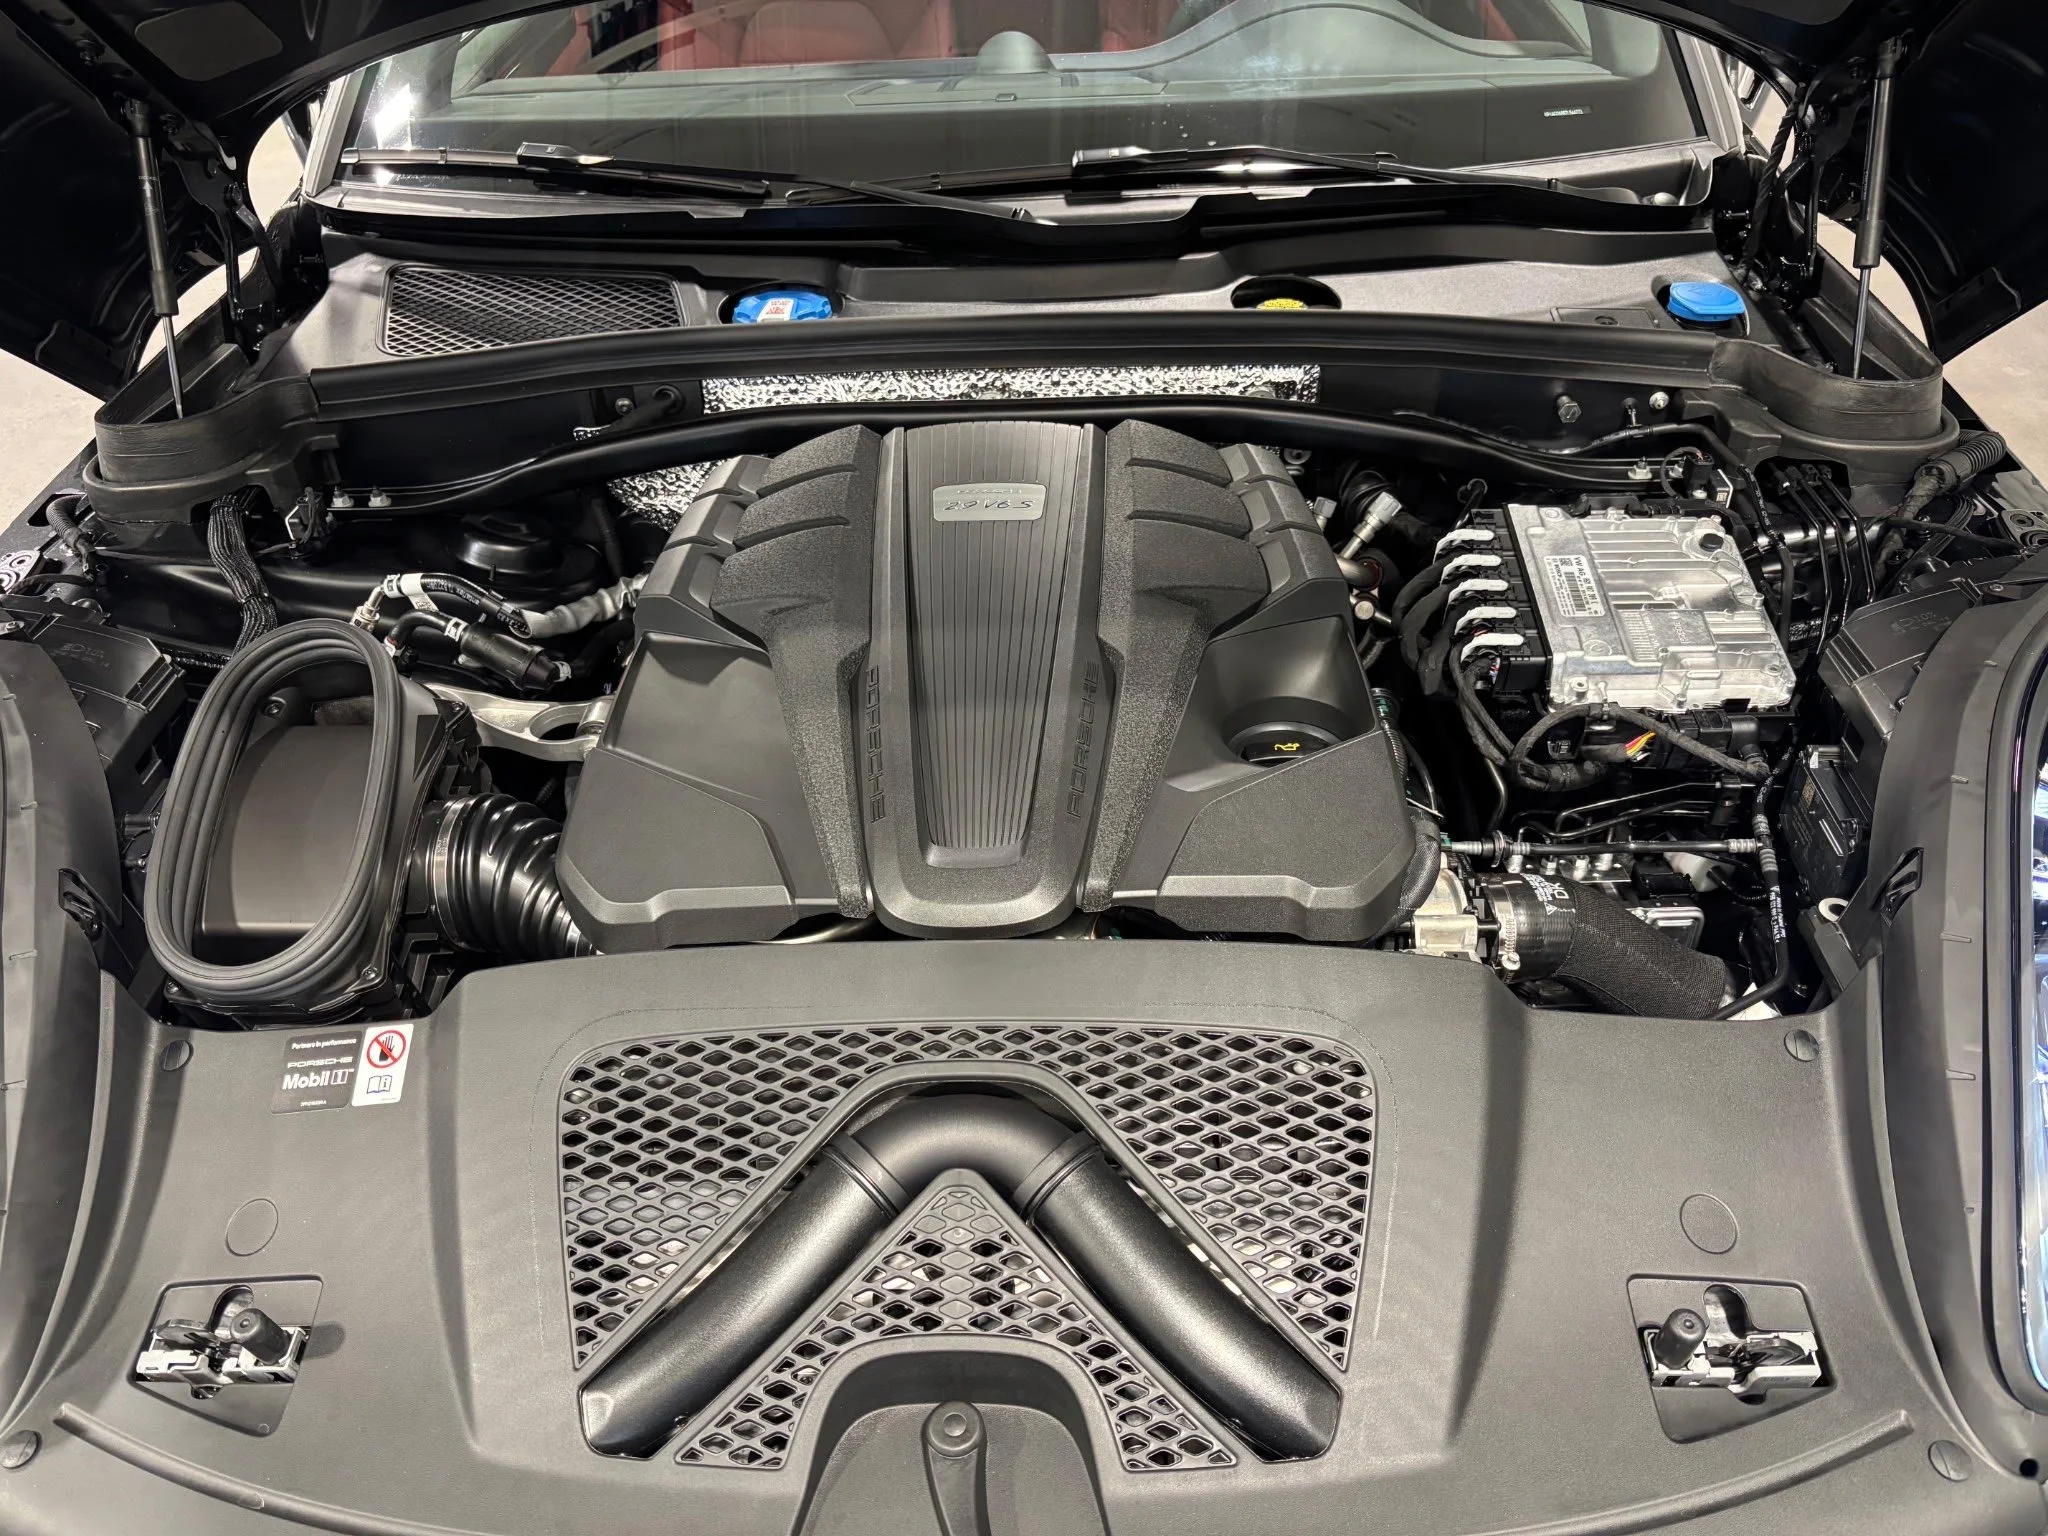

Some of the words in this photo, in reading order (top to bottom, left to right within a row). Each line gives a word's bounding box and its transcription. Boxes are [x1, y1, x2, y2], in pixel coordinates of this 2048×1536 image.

[984, 500, 1010, 509] V6
[866, 664, 886, 823] PORSCHE
[1067, 661, 1099, 818] PORSCHE
[321, 1039, 357, 1048] performance
[287, 1056, 353, 1068] PORSCHE
[282, 1071, 331, 1090] Mobil
